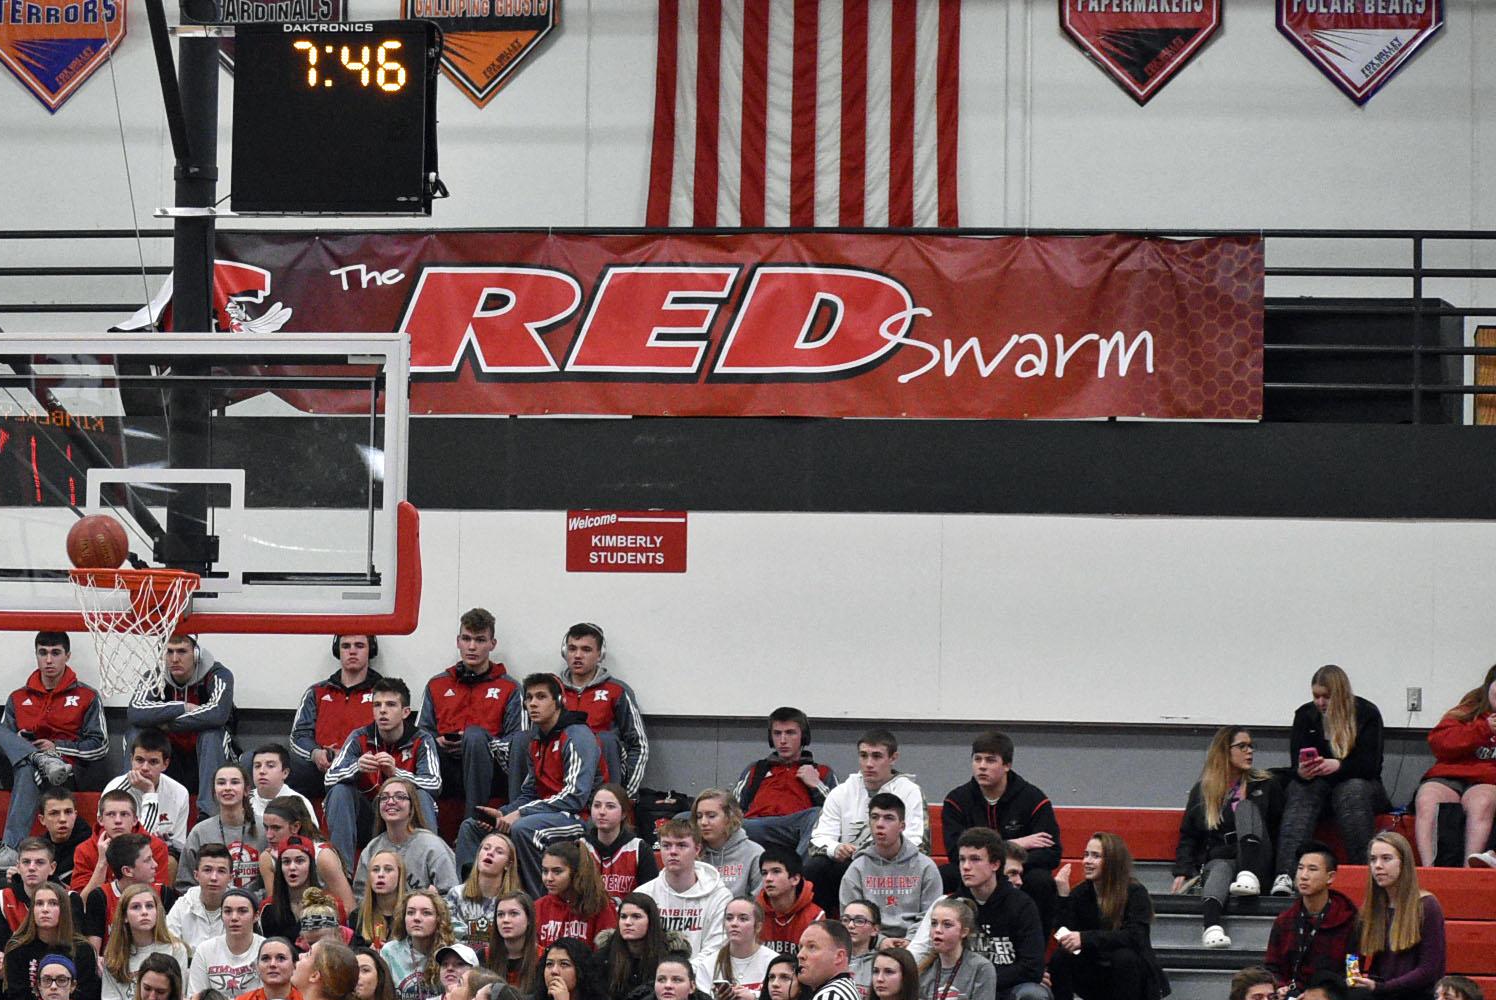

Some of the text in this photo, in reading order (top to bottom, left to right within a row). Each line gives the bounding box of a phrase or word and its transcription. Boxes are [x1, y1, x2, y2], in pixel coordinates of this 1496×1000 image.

[219, 0, 332, 22] ARDINALS
[414, 0, 548, 18] GALLOPING GHOSTS
[283, 23, 374, 32] DAKTRONICS
[293, 40, 406, 92] 7:46
[329, 263, 1155, 385] The RED Swarm
[567, 511, 617, 531] Welcome
[590, 534, 664, 548] KIMBERLY
[588, 551, 665, 565] STUDENTS
